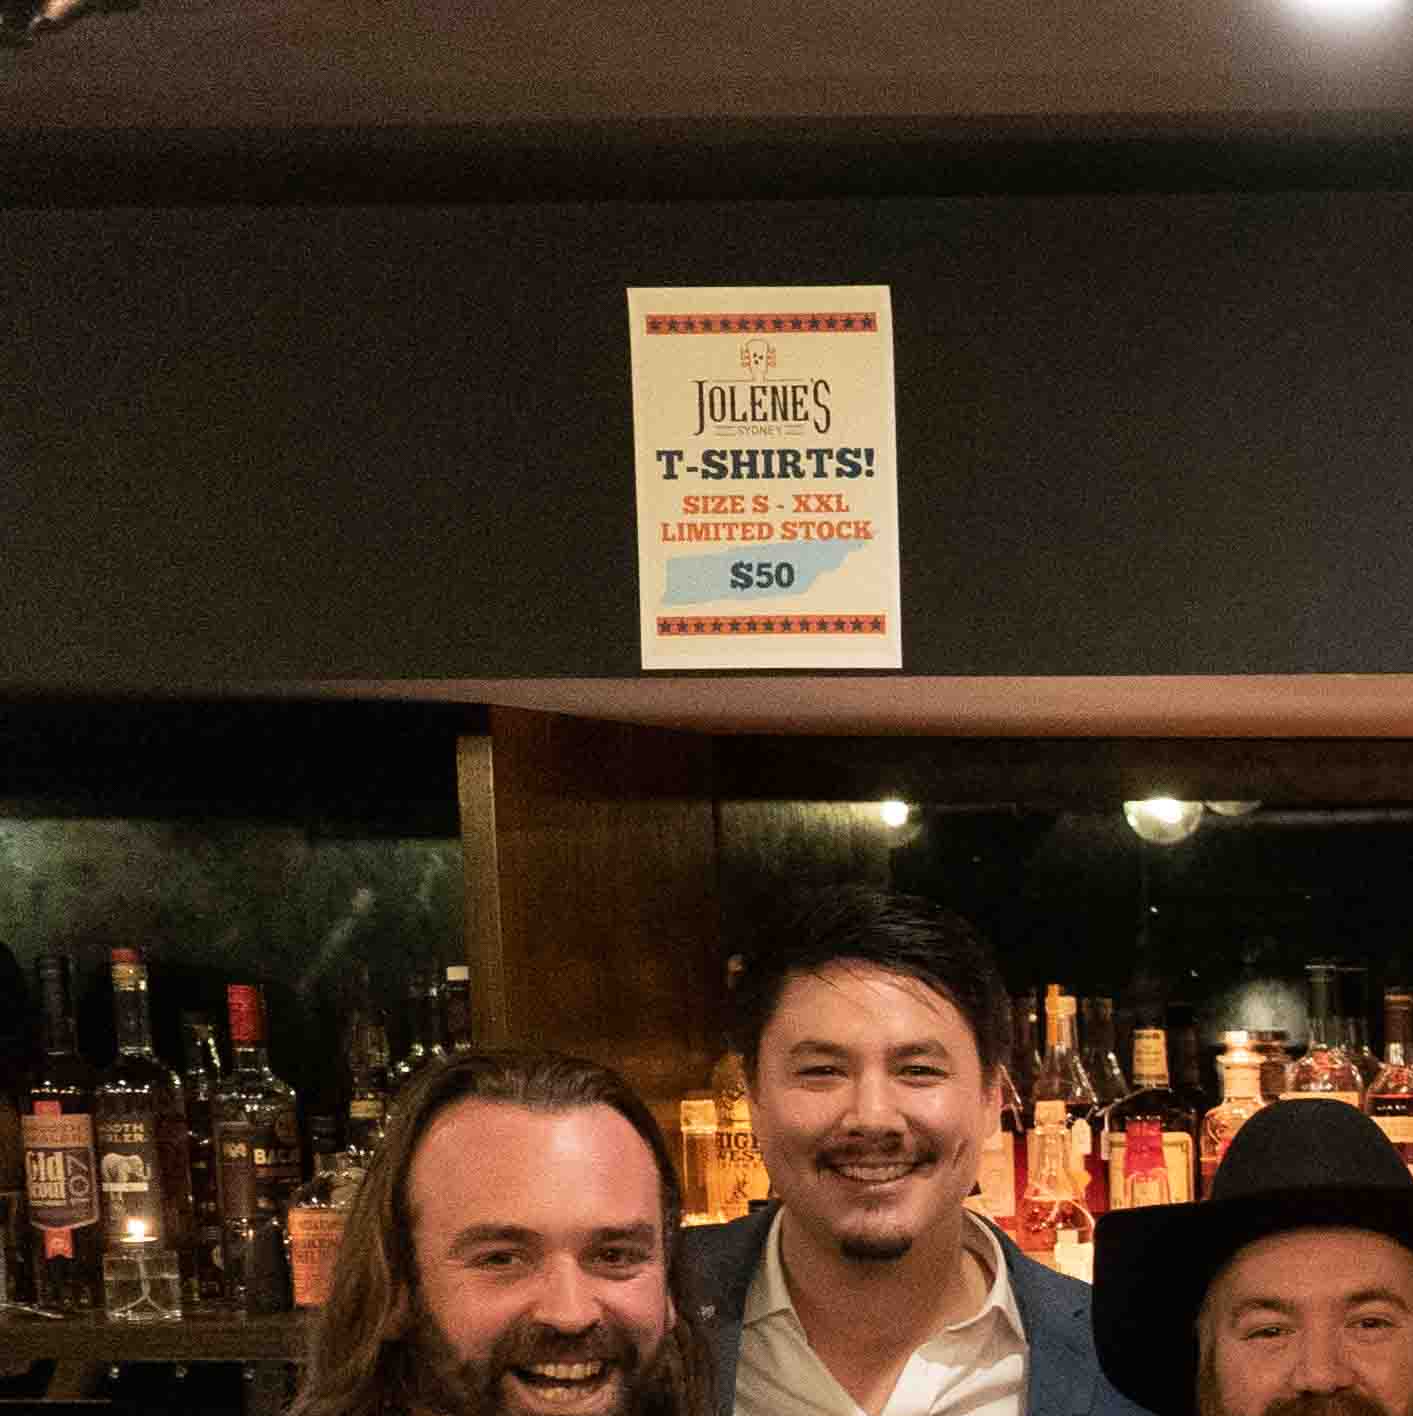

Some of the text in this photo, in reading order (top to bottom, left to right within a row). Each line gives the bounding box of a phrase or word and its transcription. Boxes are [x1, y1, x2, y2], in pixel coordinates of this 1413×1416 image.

[691, 378, 832, 437] JOLENE'S
[737, 425, 783, 437] SYDNEY
[656, 447, 876, 481] T-SHIRTS!
[682, 494, 745, 515] SIZE
[752, 494, 769, 514] S
[792, 493, 850, 513] XXL
[661, 520, 874, 543] LIMITED STOCK
[730, 560, 795, 590] $50
